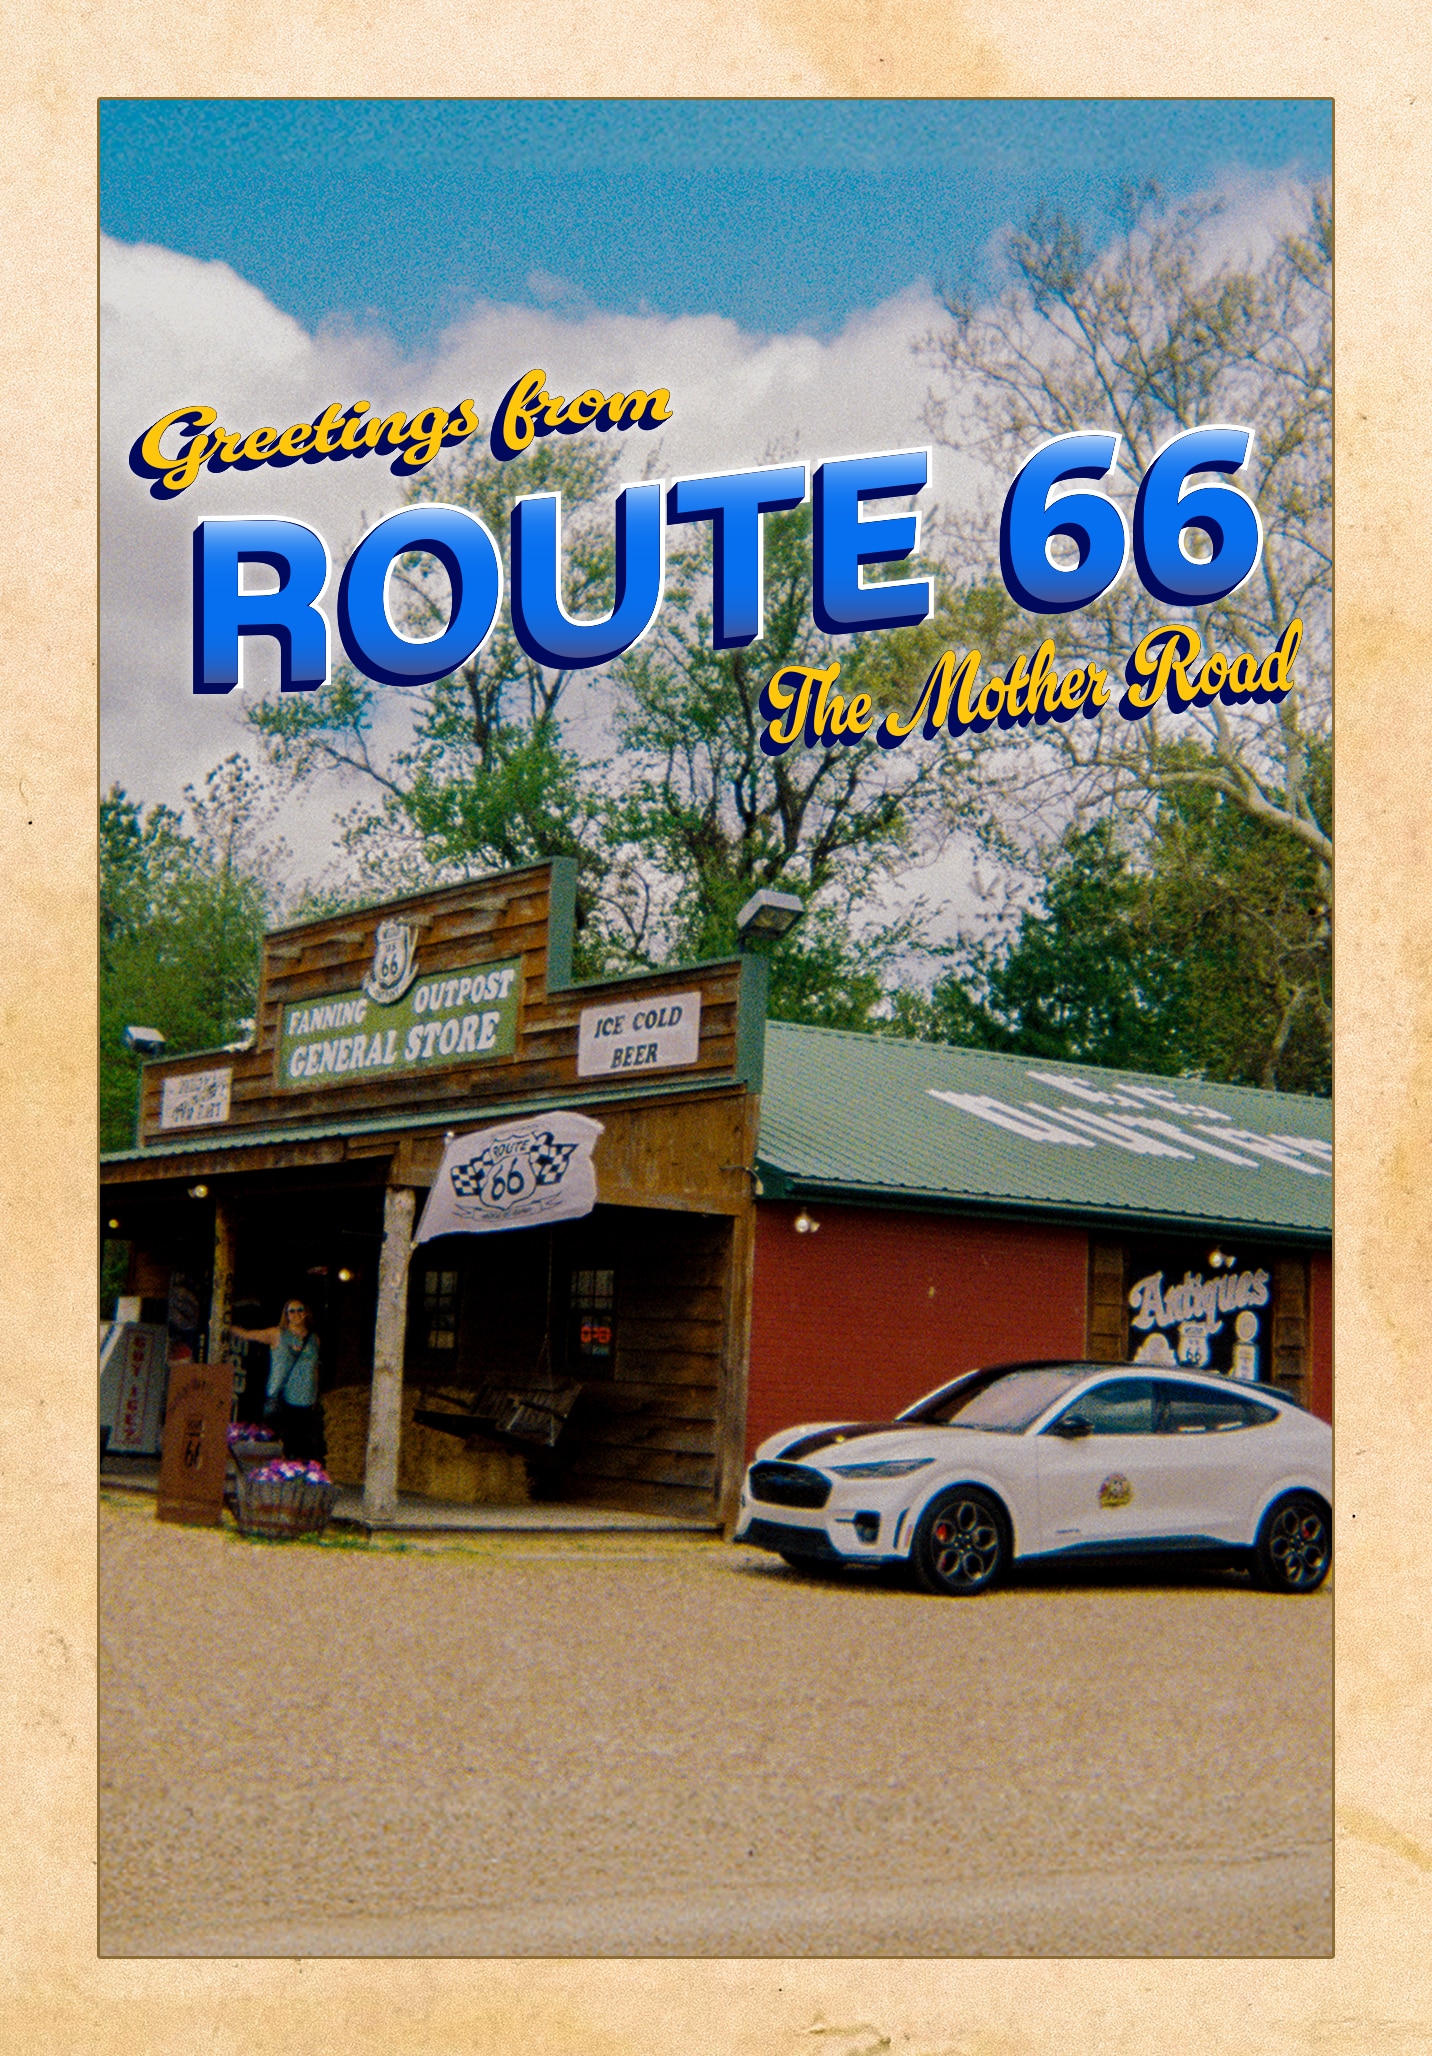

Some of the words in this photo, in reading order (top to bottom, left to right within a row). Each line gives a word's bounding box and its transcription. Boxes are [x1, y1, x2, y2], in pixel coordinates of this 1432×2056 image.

[381, 953, 399, 978] 66
[287, 998, 369, 1036] FANNING
[412, 968, 516, 1014] OUTPOST
[594, 1014, 626, 1039] ICE
[632, 1005, 683, 1032] COLD
[288, 1030, 398, 1078] GENERAL
[404, 1011, 501, 1062] STORE
[610, 1042, 658, 1069] BEER
[492, 1138, 531, 1158] ROUTE
[491, 1157, 525, 1201] 66
